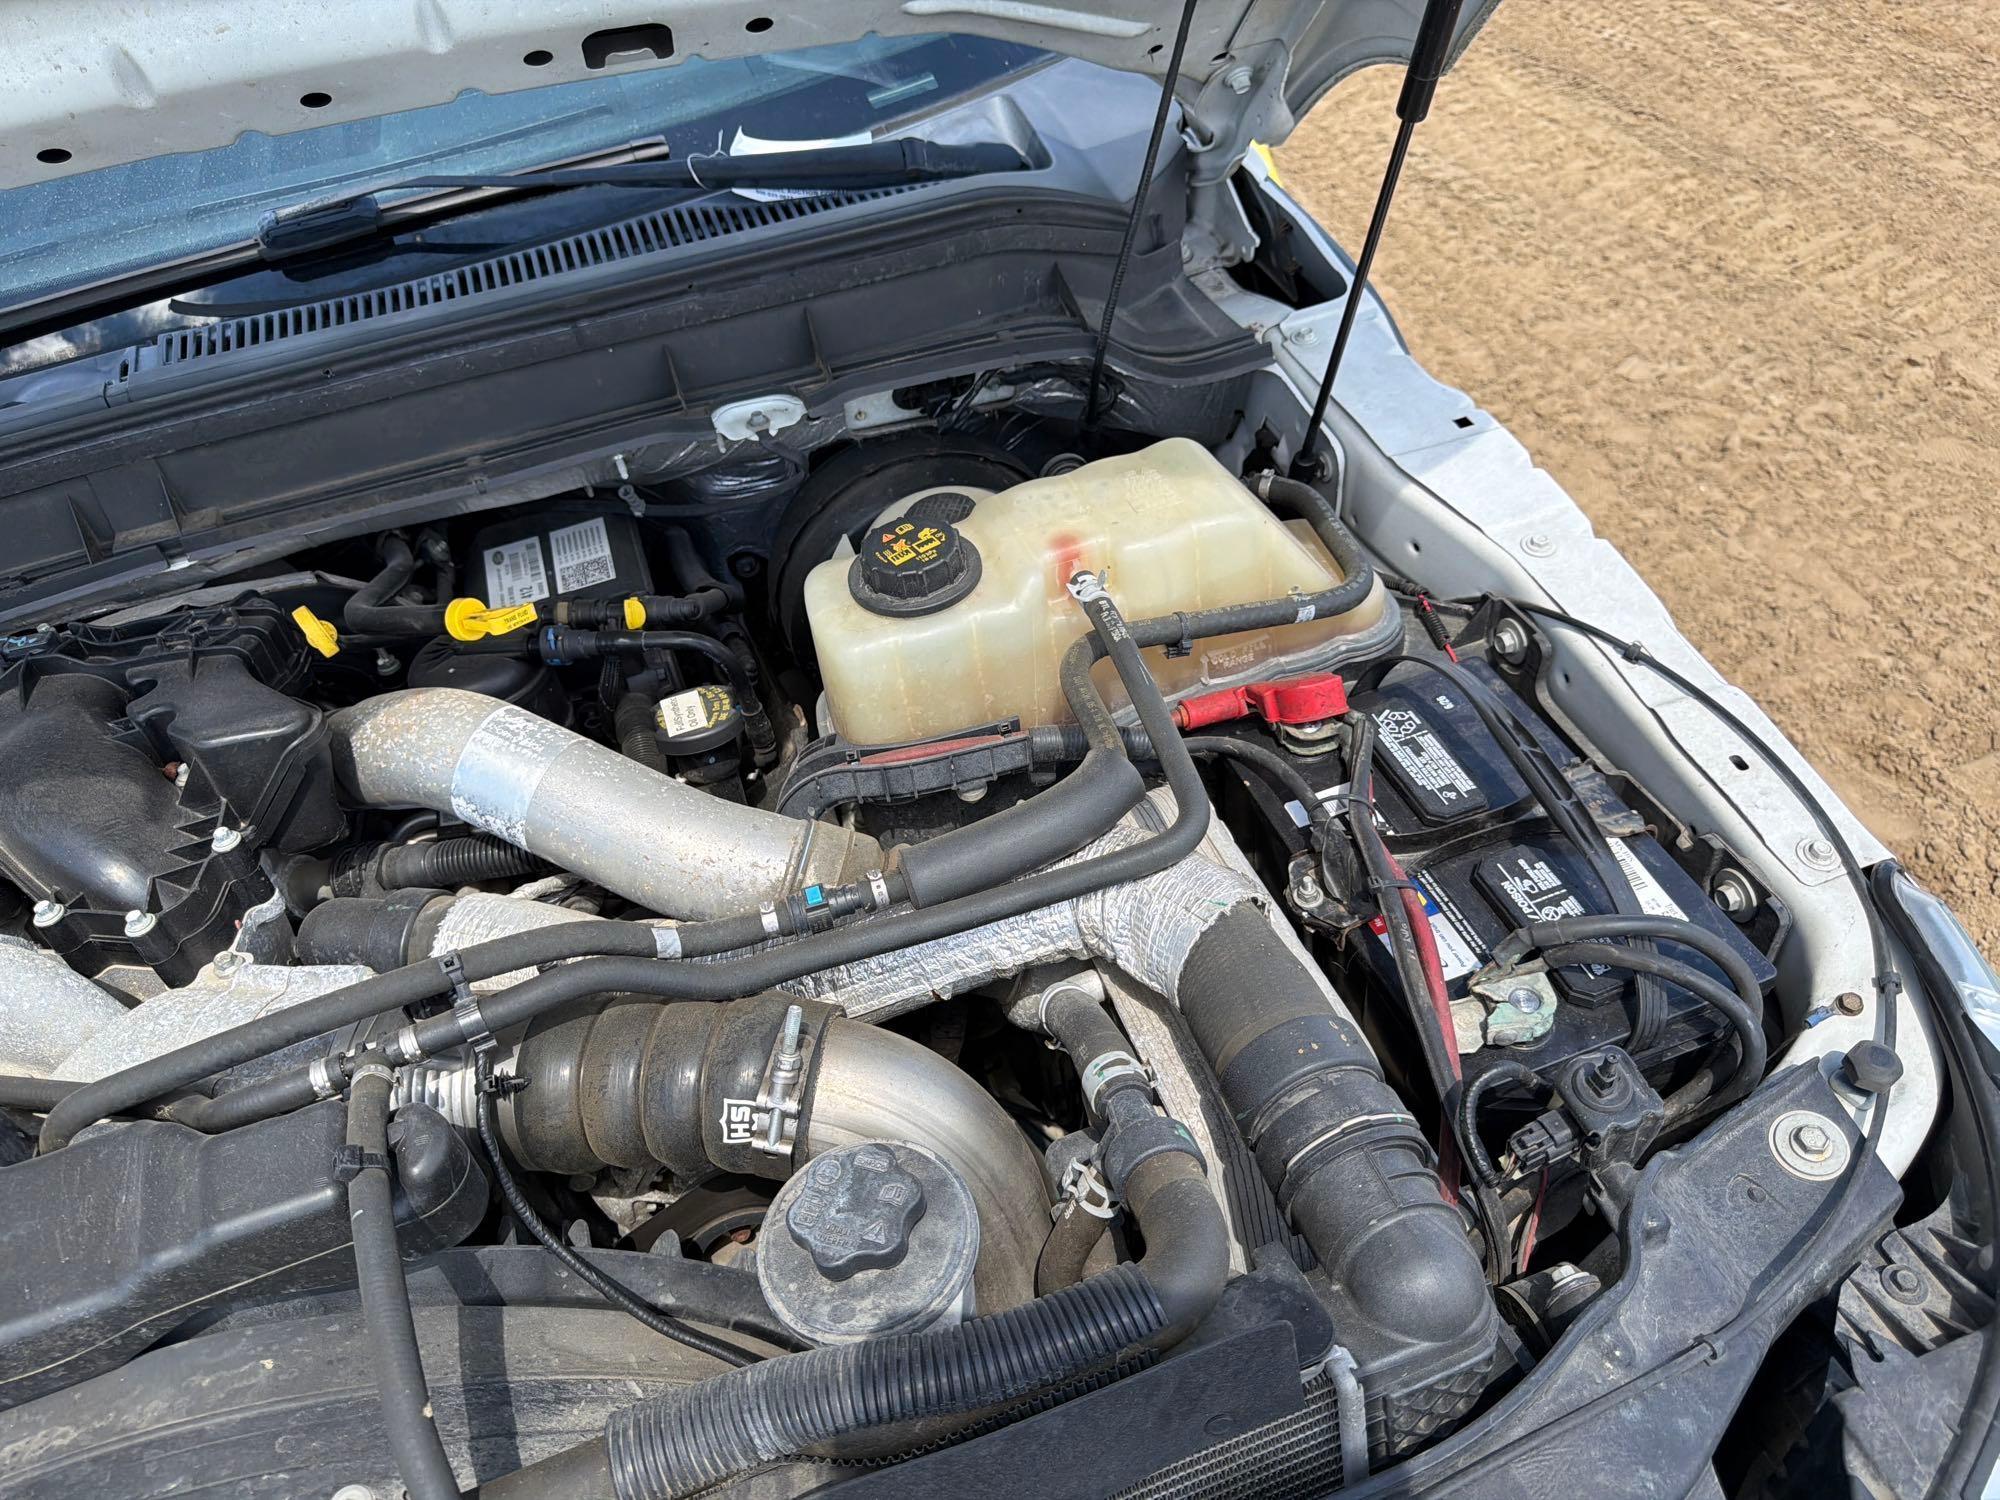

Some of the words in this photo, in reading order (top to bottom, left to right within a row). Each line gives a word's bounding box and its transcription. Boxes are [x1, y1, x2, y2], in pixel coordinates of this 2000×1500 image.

[520, 585, 534, 599] 412
[1210, 650, 1237, 665] COLD
[1241, 641, 1266, 655] FILL
[1223, 653, 1256, 669] RANGE
[1438, 933, 1448, 943] can
[1445, 942, 1456, 953] you
[1452, 951, 1467, 968] Power
[730, 1106, 751, 1138] HS
